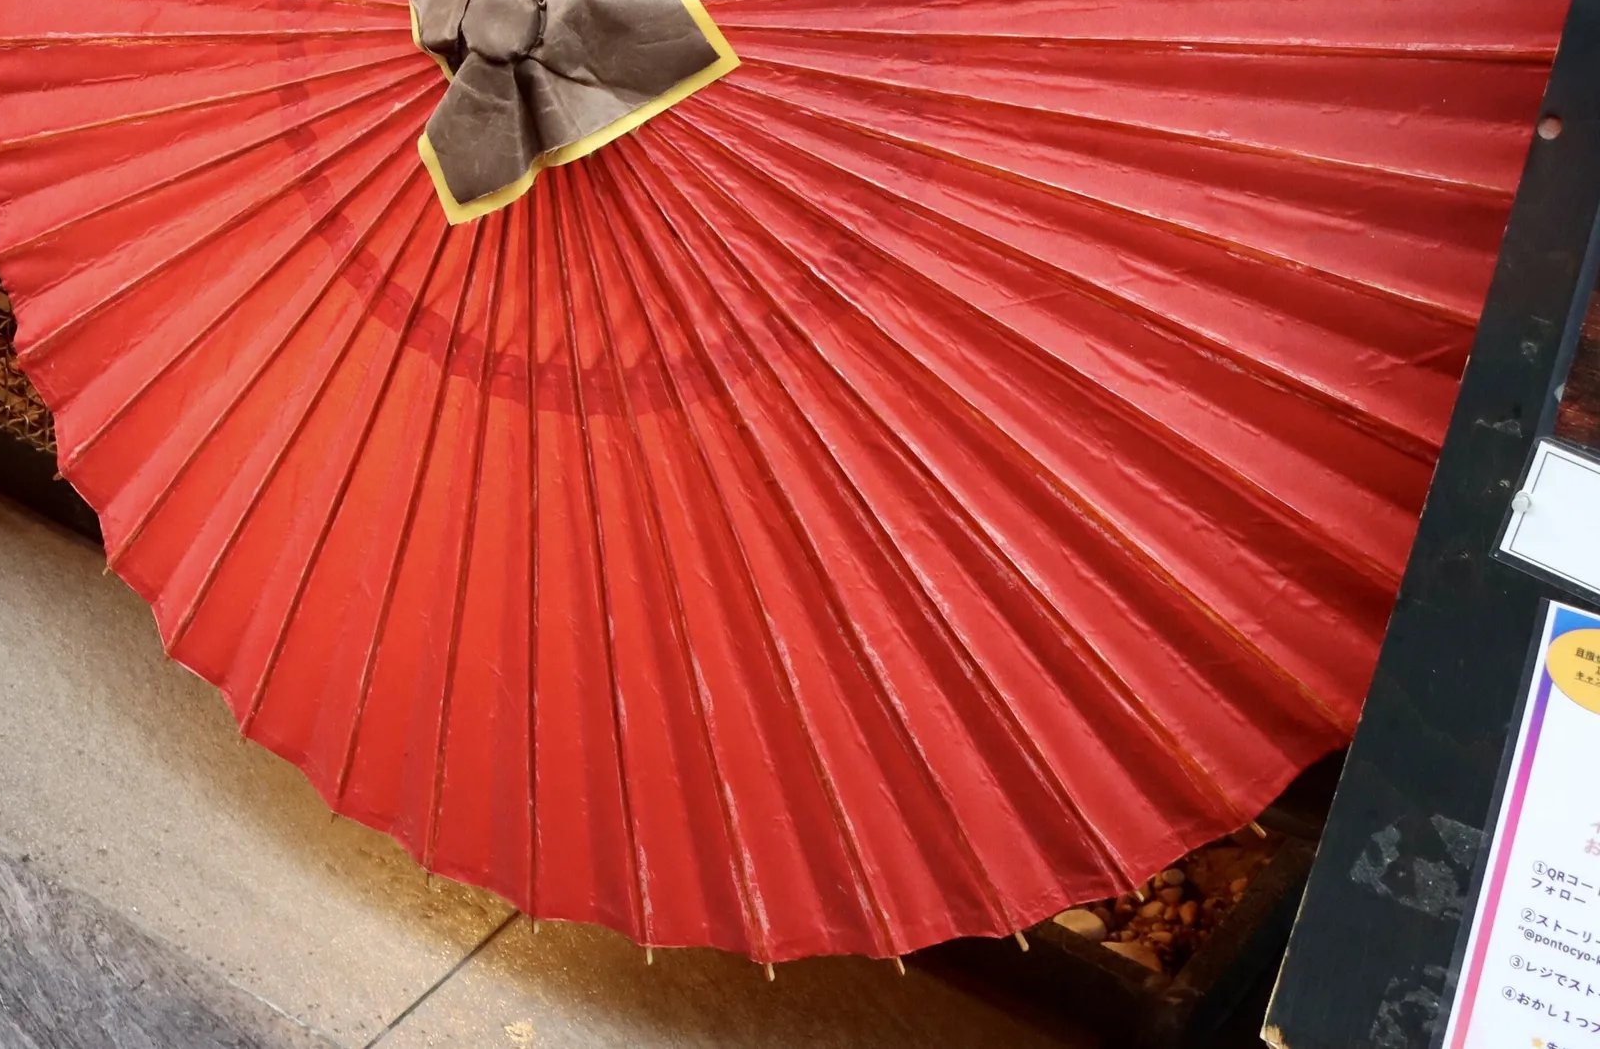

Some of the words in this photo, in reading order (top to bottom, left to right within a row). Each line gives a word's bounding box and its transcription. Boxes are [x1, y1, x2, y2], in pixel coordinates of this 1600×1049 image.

[1531, 877, 1586, 904] フォロー
[1532, 860, 1600, 896] ①QRコー
[1509, 954, 1600, 997] ③レジでスト
